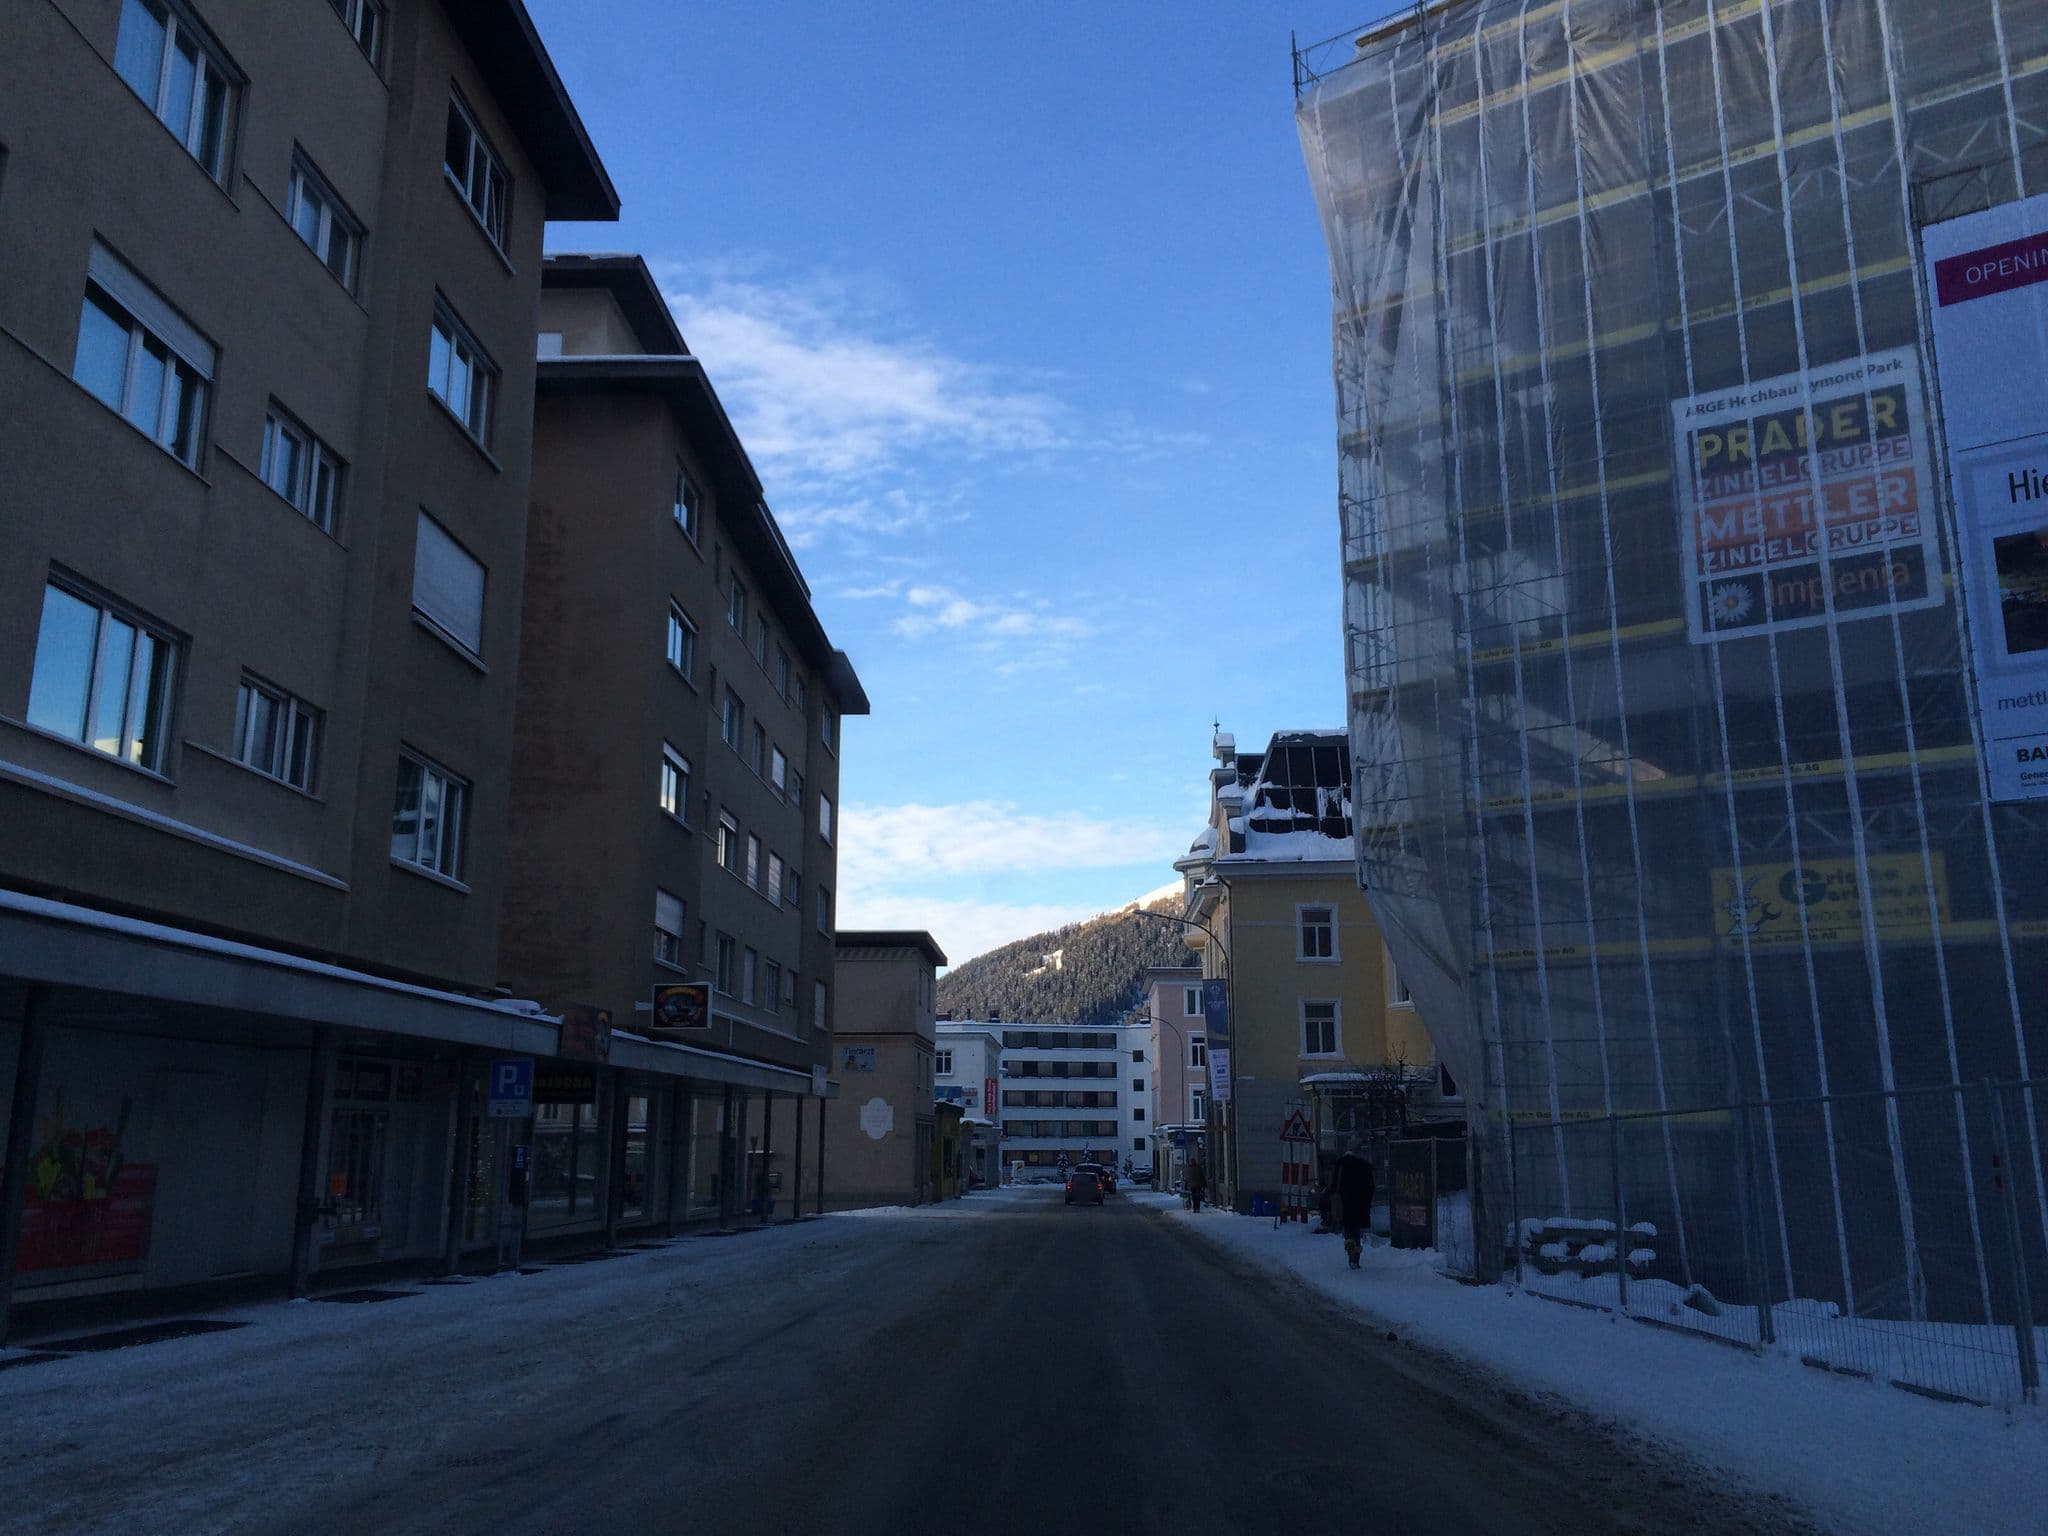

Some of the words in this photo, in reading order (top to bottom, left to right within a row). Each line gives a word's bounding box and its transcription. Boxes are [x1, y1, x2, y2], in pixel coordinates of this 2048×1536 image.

[1867, 358, 1904, 378] Park
[1697, 395, 1898, 470] PRADER
[1704, 475, 1909, 543] METTLER
[2017, 745, 2048, 763] BA
